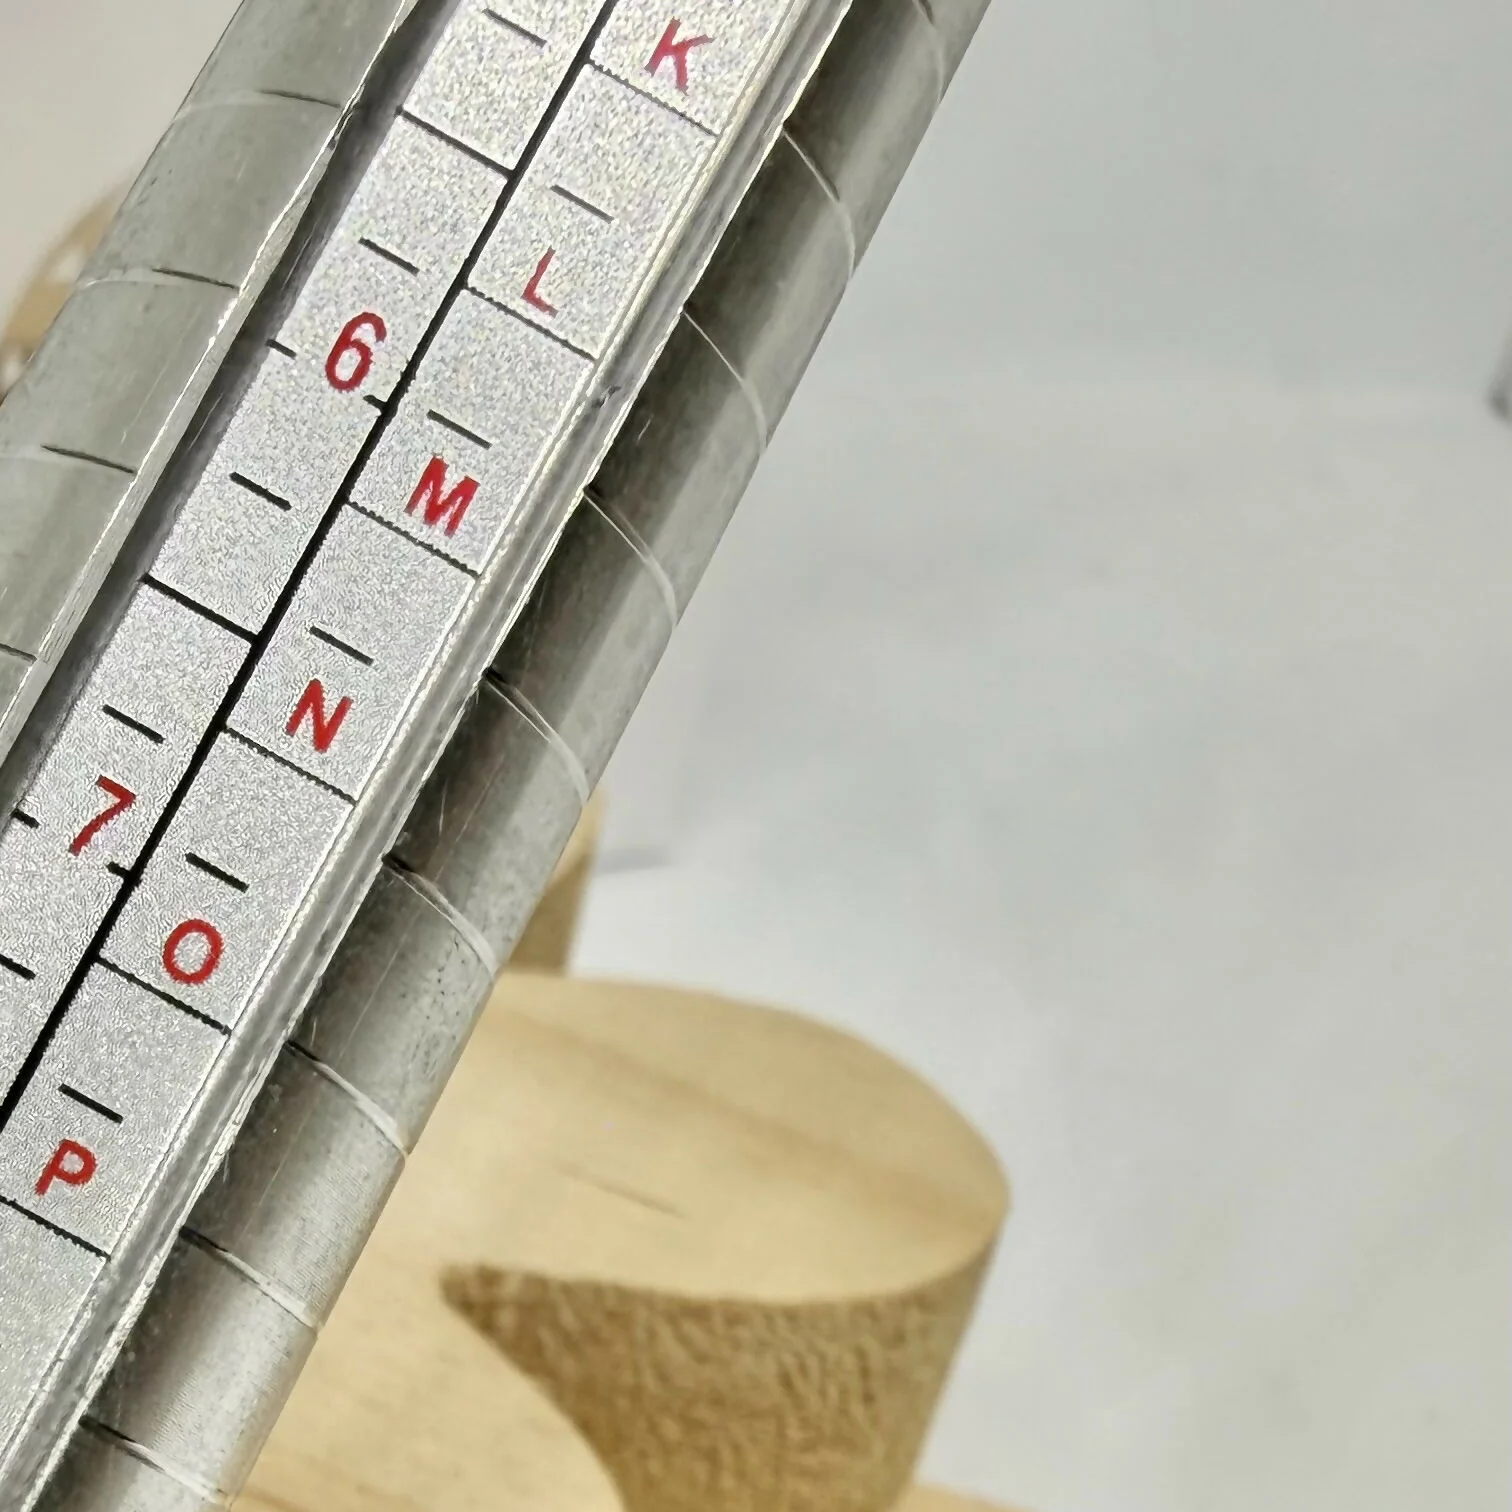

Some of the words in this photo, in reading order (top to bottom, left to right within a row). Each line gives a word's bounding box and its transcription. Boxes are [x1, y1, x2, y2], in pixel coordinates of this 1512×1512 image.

[643, 18, 712, 92] K
[522, 248, 557, 316] L
[324, 312, 386, 391] 6
[405, 456, 479, 535] M
[284, 680, 351, 753] N
[70, 777, 137, 854] 7
[161, 918, 224, 985] O
[36, 1138, 96, 1196] P
